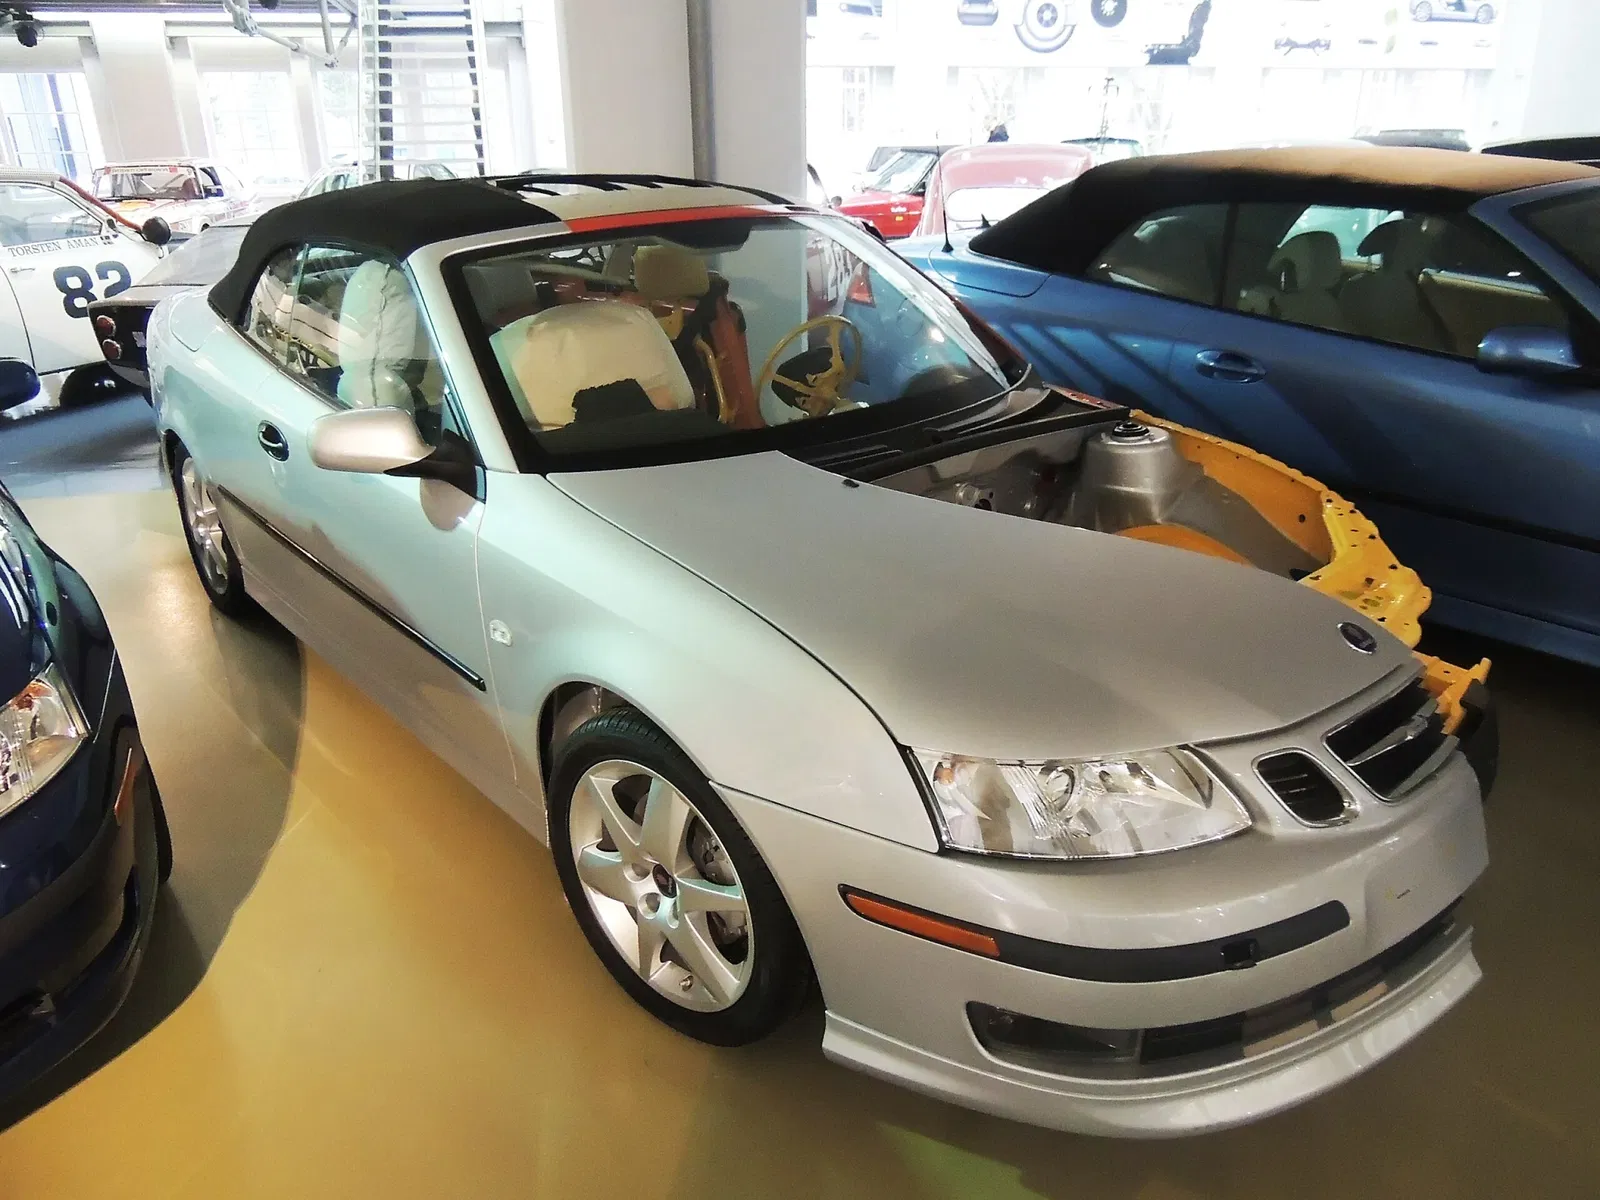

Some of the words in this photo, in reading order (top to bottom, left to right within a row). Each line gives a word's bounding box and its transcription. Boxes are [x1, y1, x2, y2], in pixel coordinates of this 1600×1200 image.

[8, 241, 62, 257] TORSTEN
[66, 236, 99, 250] AMAN
[53, 260, 131, 318] 82
